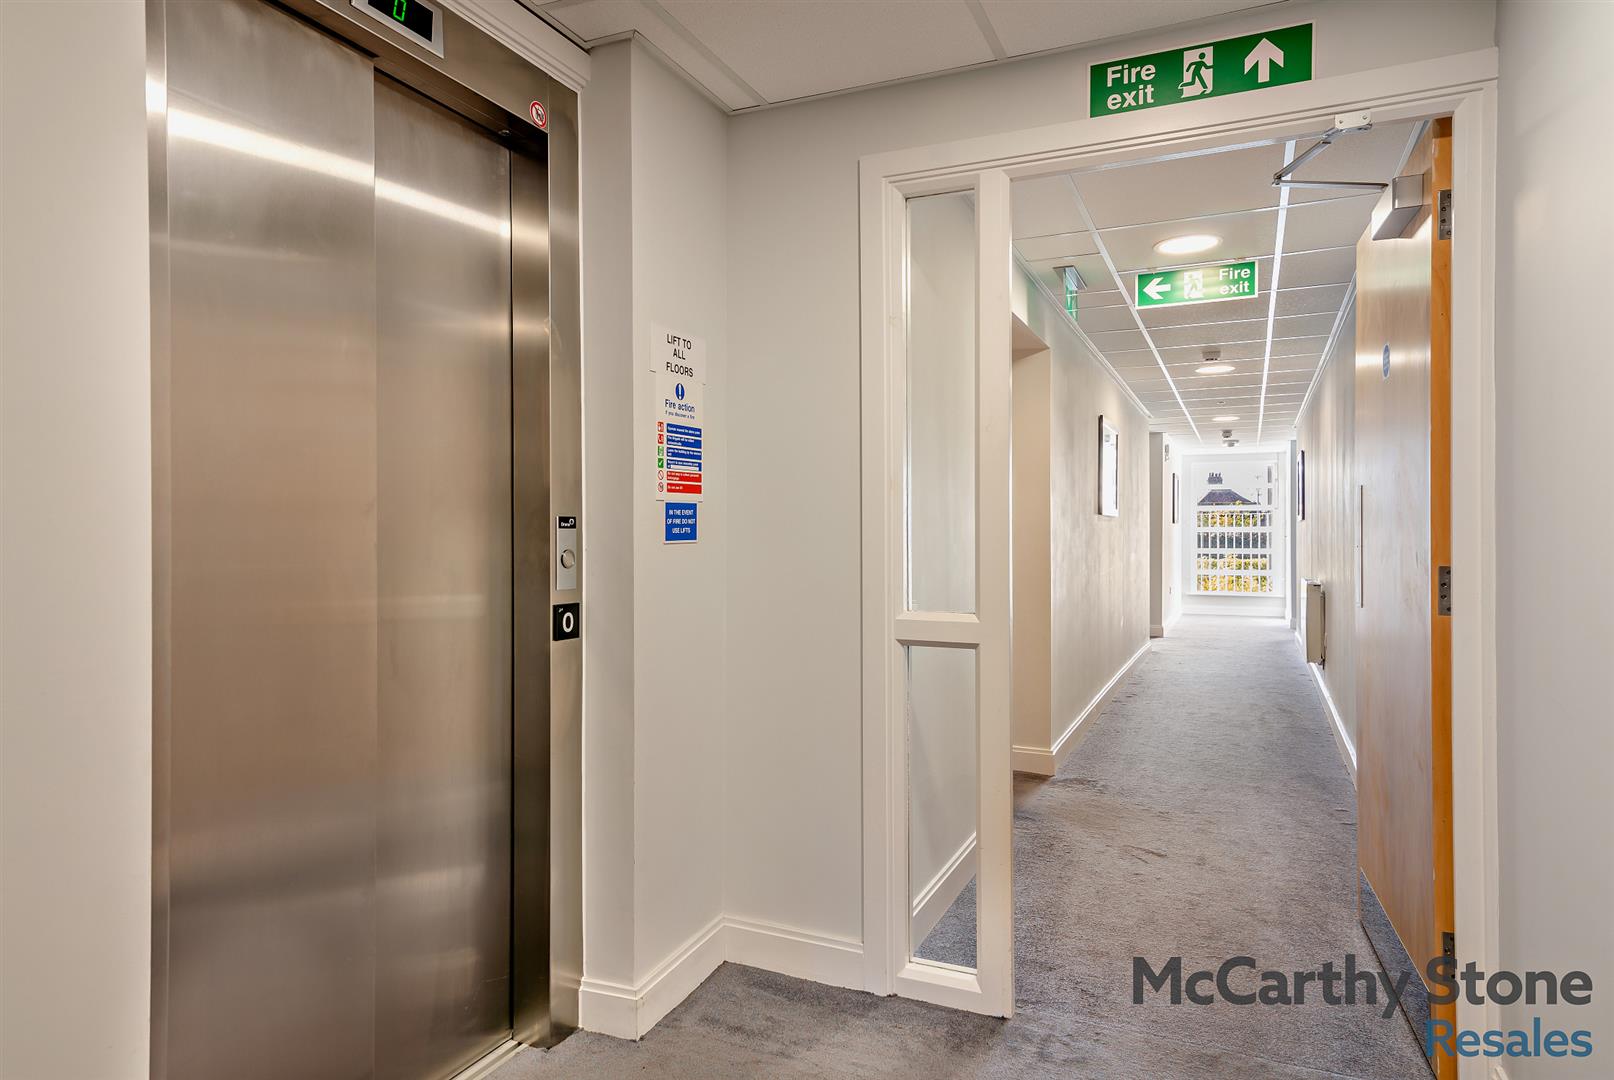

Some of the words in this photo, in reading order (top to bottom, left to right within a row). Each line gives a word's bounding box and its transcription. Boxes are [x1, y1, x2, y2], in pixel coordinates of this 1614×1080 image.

[393, 0, 406, 21] 0
[1107, 64, 1156, 87] Fire
[1107, 84, 1154, 110] exit
[1219, 268, 1251, 280] Fire
[1219, 281, 1249, 295] exit
[667, 334, 681, 346] LIFT
[682, 339, 692, 349] TO
[673, 348, 686, 360] ALL
[666, 362, 693, 377] FLOORS
[665, 399, 676, 409] Fire
[678, 403, 695, 413] action
[562, 612, 574, 633] 0
